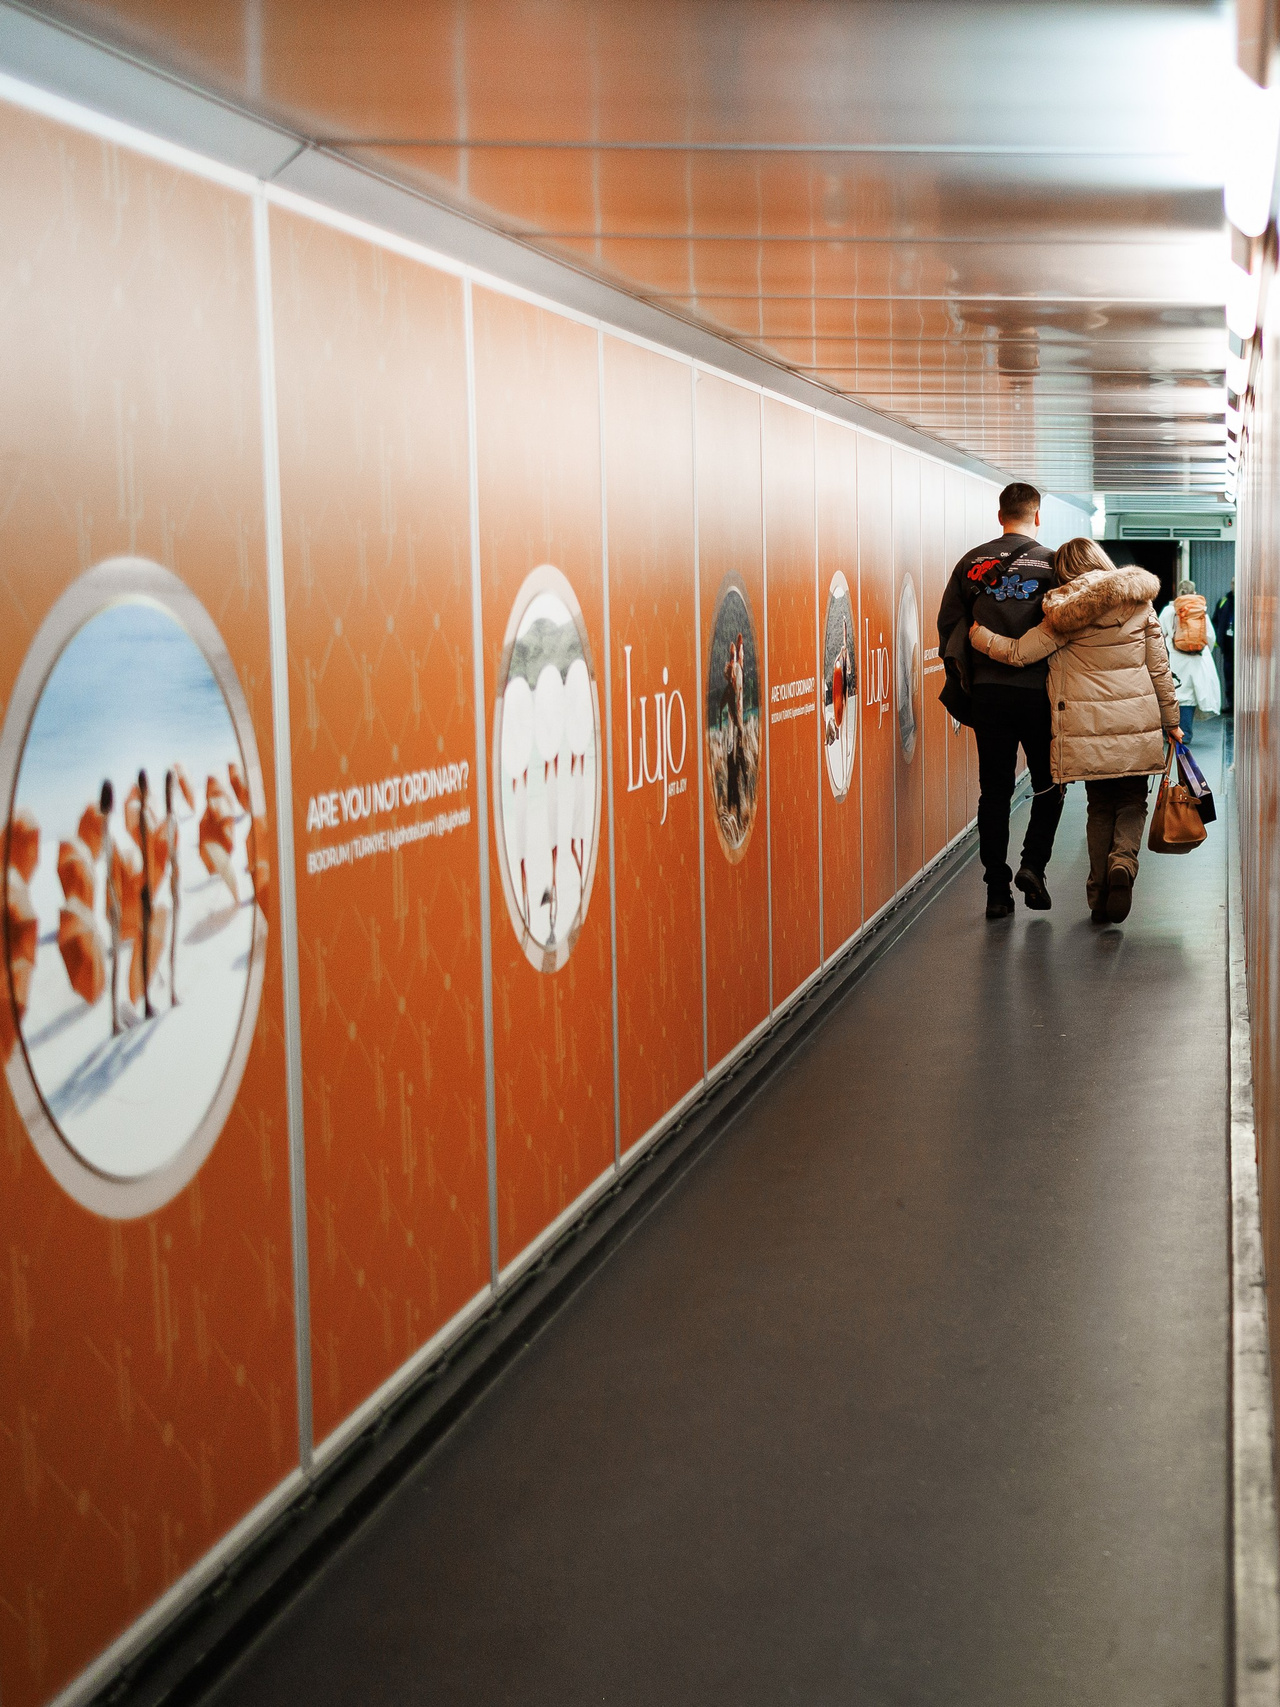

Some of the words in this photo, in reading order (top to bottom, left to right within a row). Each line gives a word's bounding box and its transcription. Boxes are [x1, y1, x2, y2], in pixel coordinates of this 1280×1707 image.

[865, 618, 889, 730] Lujo
[624, 645, 687, 825] Lujo
[307, 792, 339, 832] ARE
[340, 784, 371, 822] YOU
[373, 777, 401, 813] NOT
[401, 760, 469, 806] ORDINARY?
[307, 843, 350, 875] BODRUM
